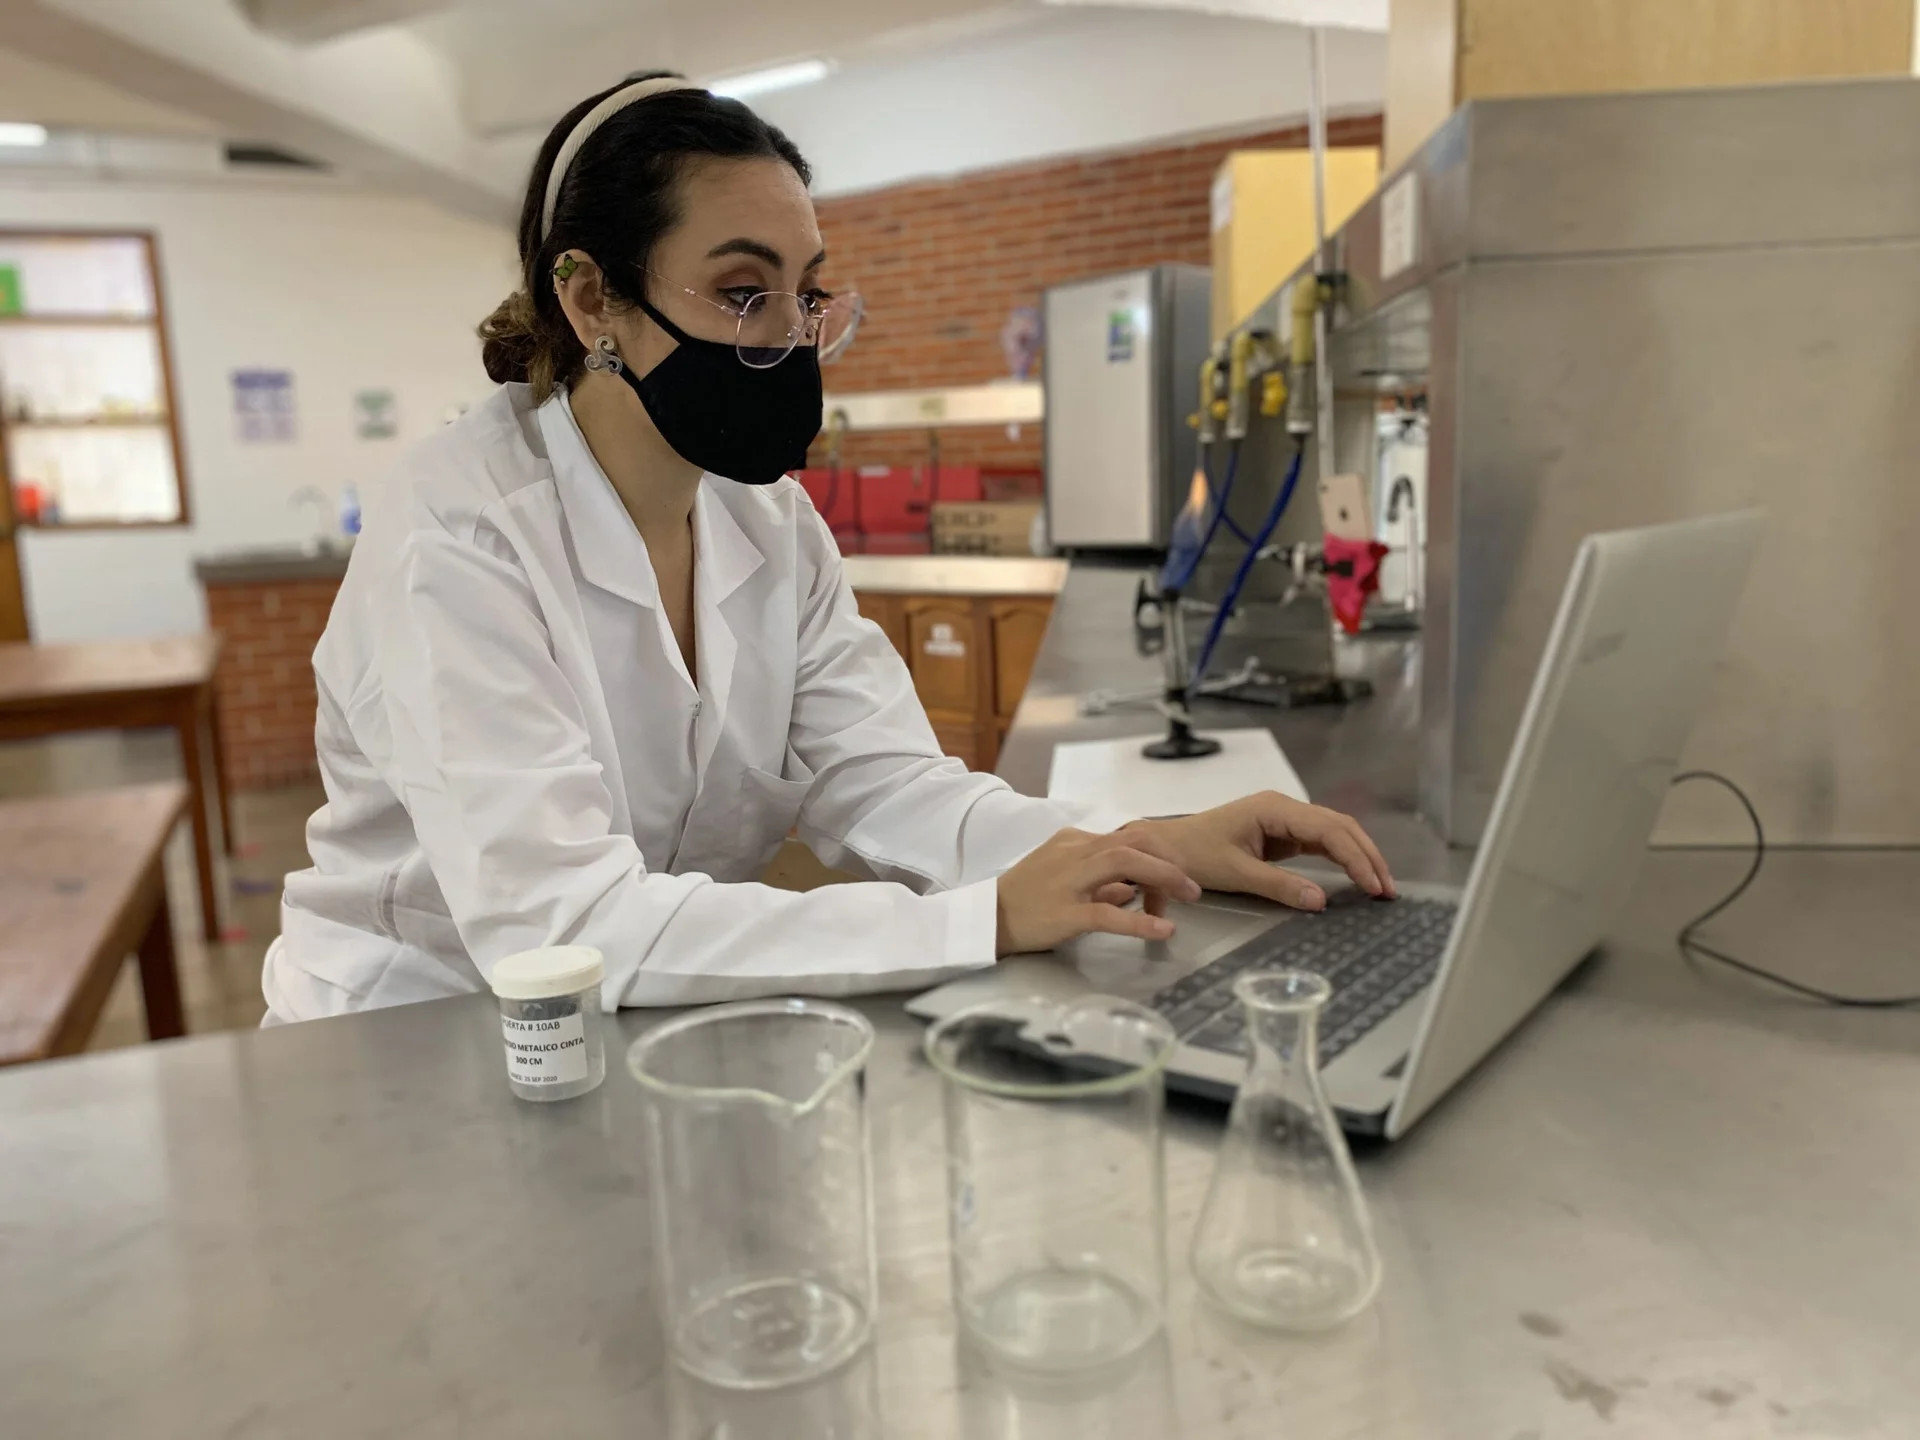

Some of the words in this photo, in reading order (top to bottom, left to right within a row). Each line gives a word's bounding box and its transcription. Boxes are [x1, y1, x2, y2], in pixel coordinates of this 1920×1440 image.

[536, 1021, 561, 1032] 10AB
[517, 1043, 558, 1052] METALICO
[560, 1036, 585, 1050] CINTA
[529, 1058, 543, 1066] CM
